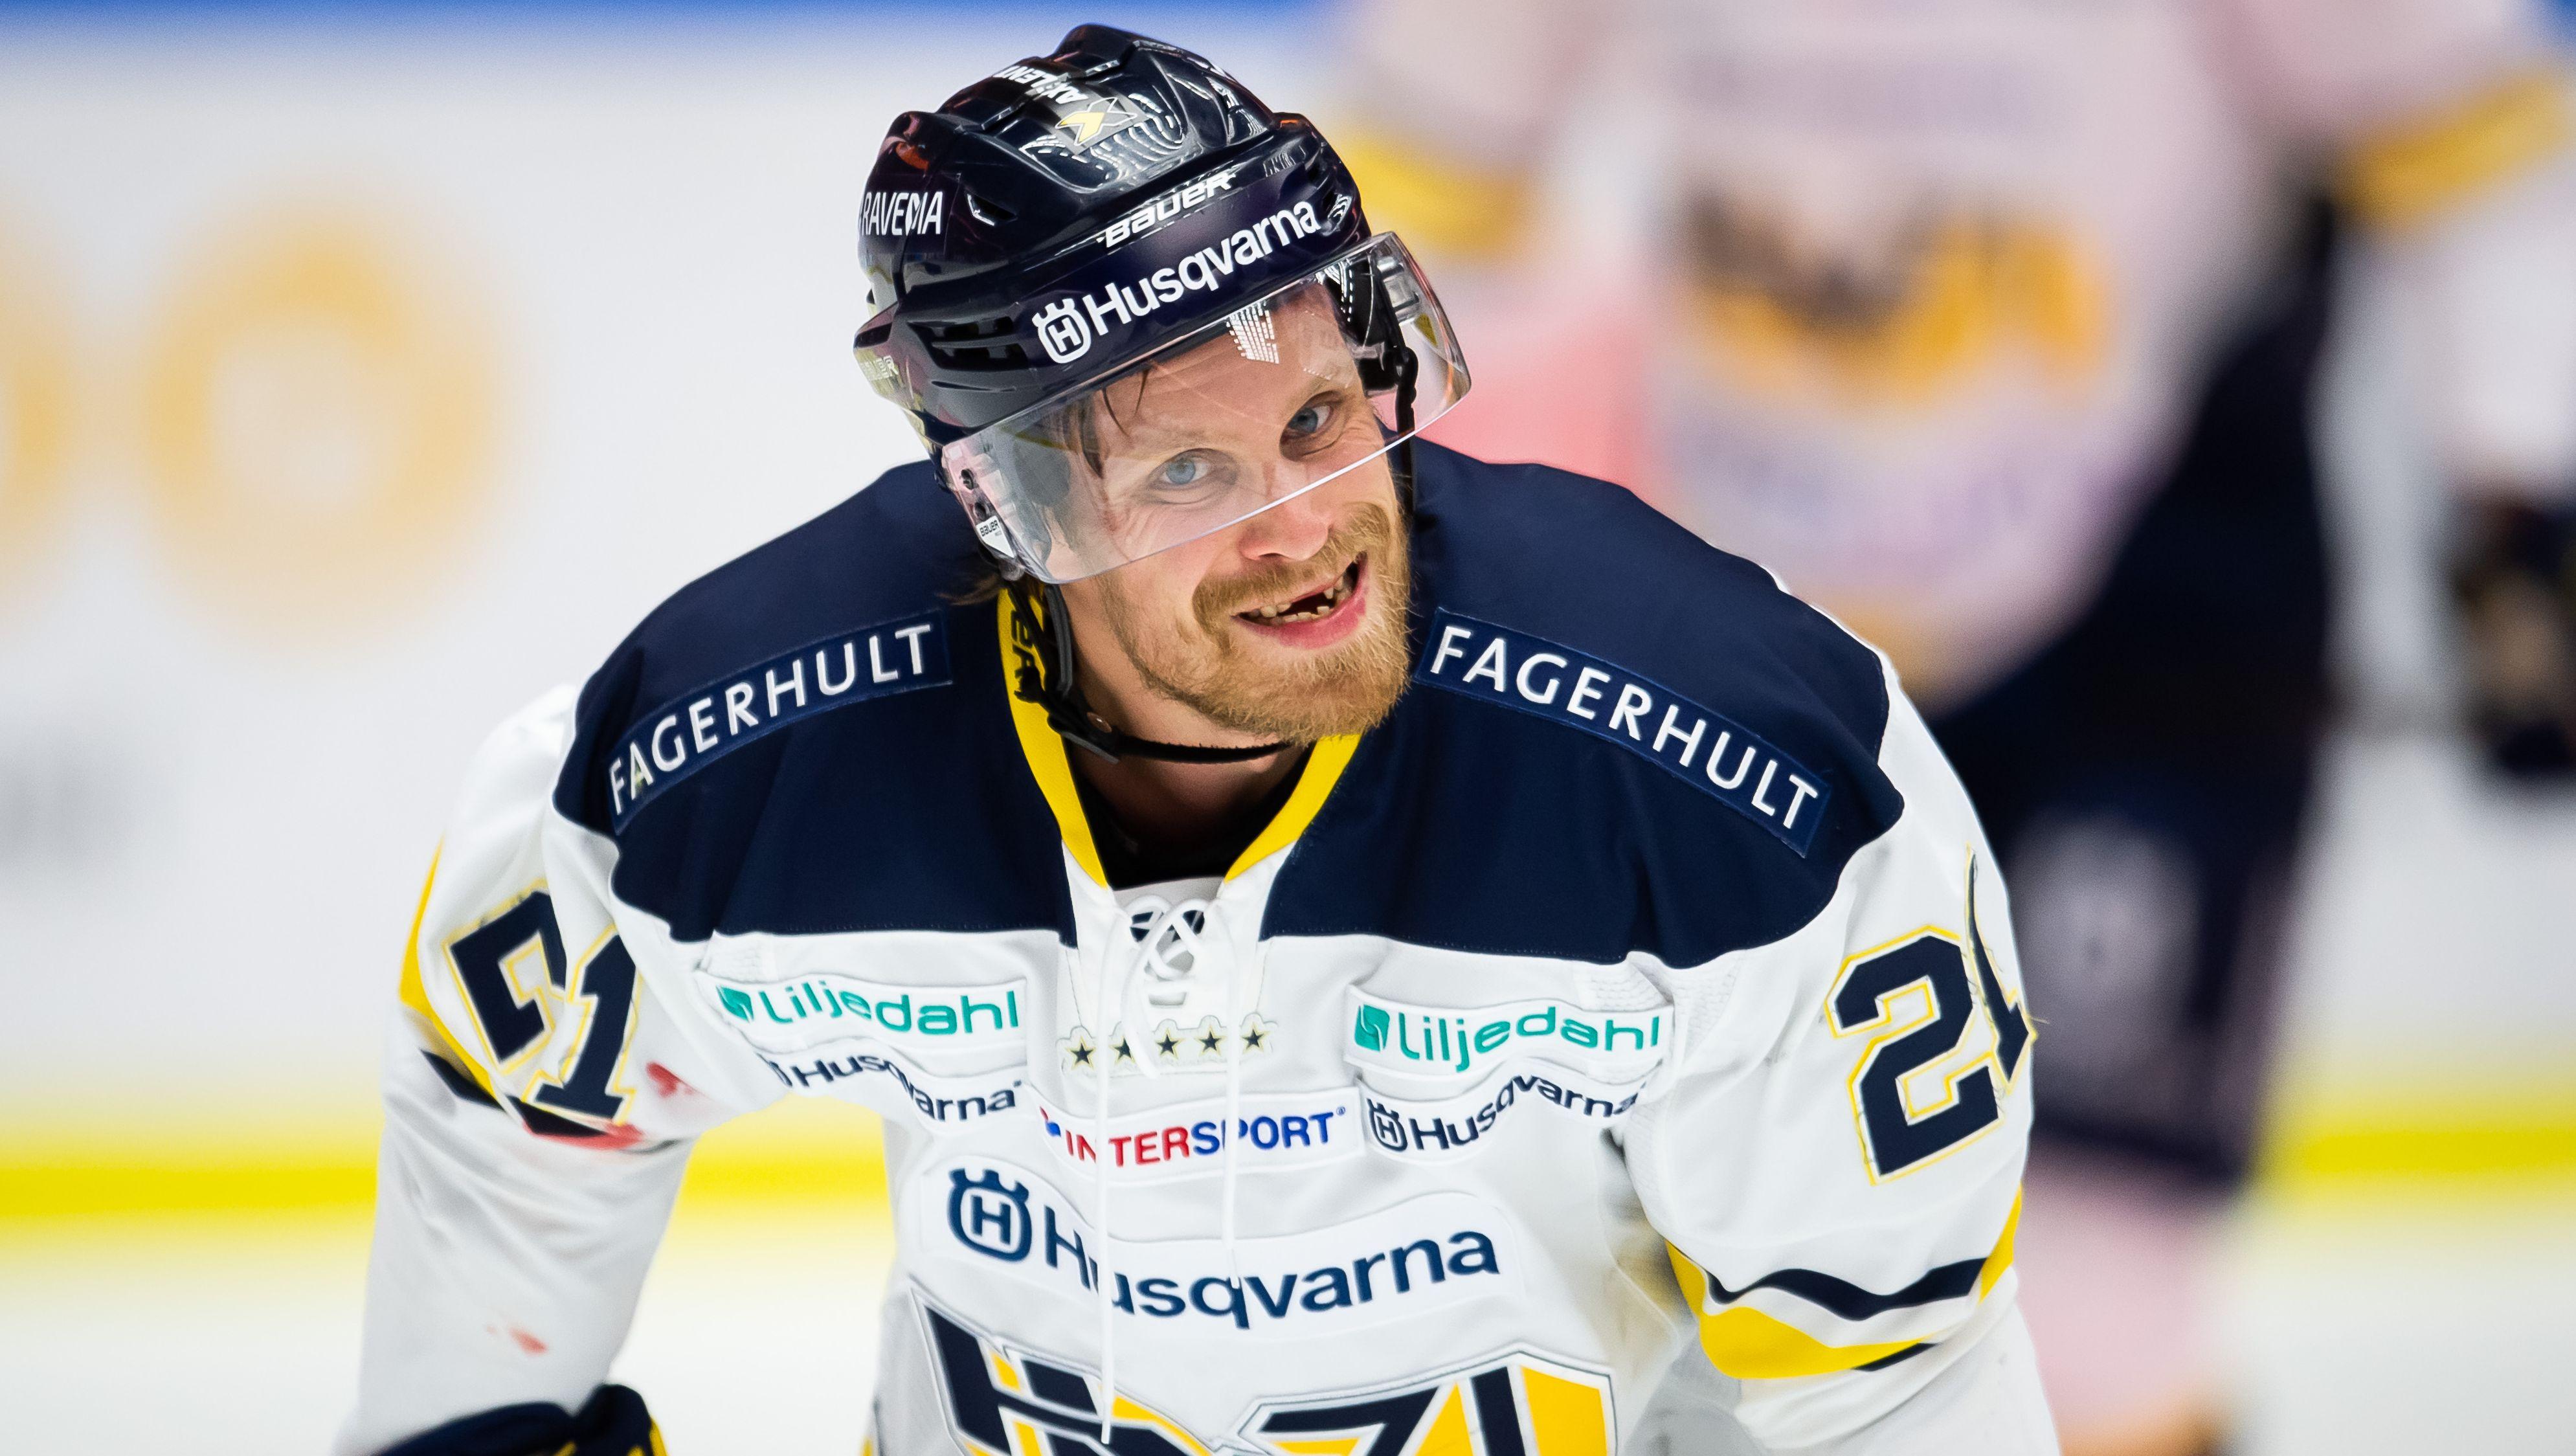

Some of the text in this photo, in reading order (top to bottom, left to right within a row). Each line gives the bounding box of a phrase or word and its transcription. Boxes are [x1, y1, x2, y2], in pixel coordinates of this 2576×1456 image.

[1082, 201, 1321, 336] Husqvarna
[608, 623, 931, 816] FAGERHULT
[1429, 625, 1819, 829] FAGERHULT
[759, 980, 1020, 1036] Liljedahl
[1398, 1005, 1661, 1073] Liljedahl
[1043, 1202, 1500, 1331] Husqvarna
